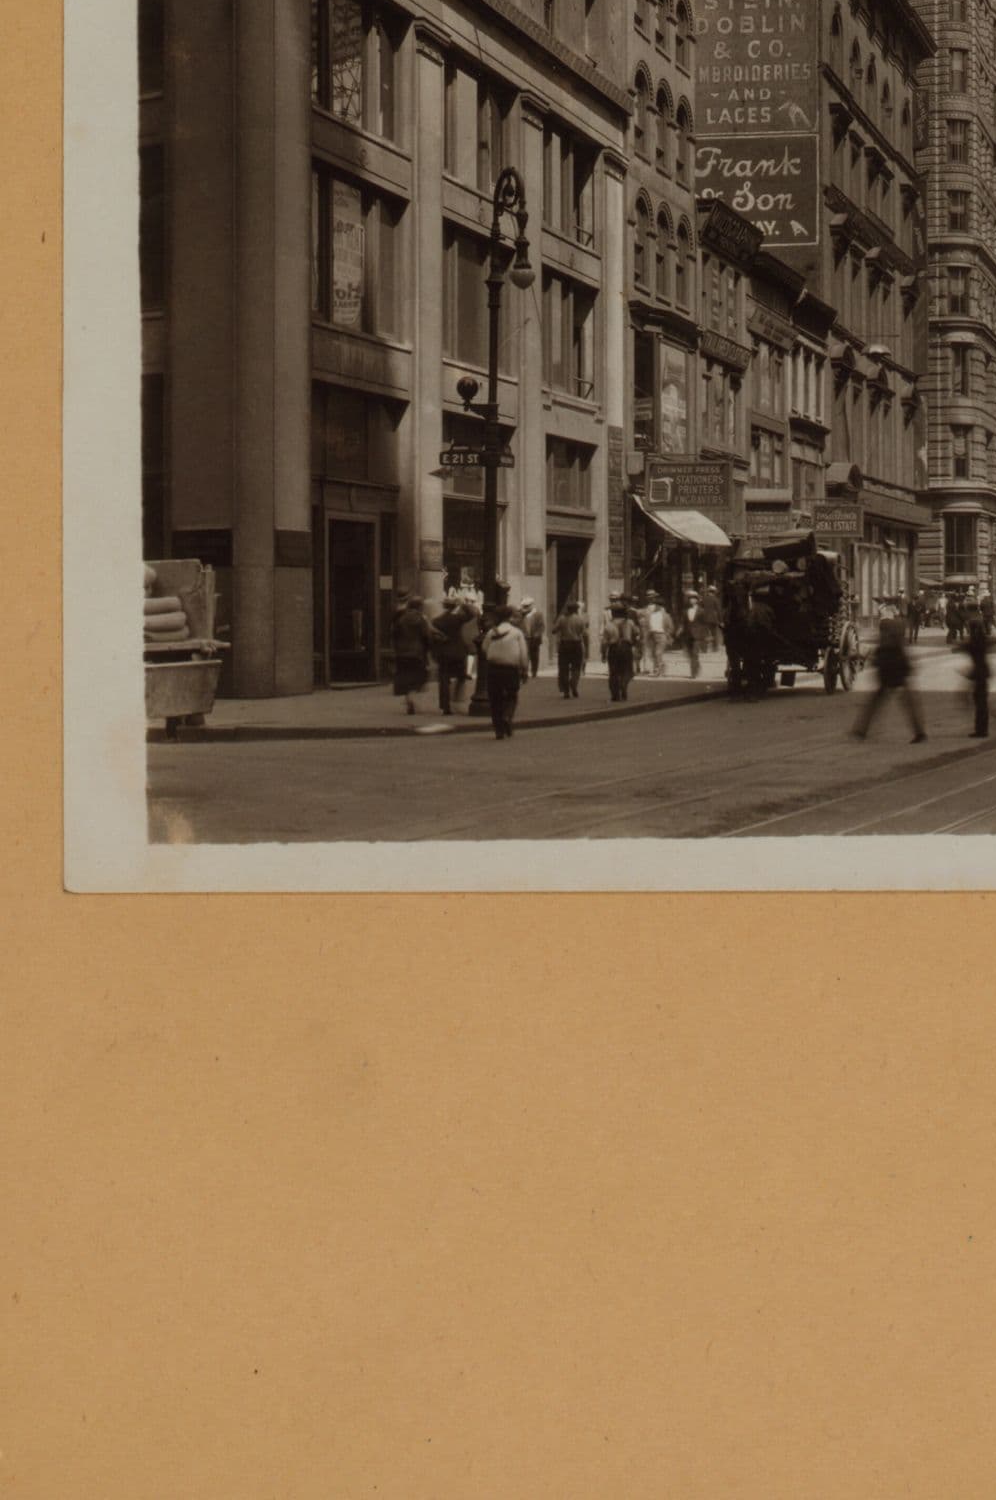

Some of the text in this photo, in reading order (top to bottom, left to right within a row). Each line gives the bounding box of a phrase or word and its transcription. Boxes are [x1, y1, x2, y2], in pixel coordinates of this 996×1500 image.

[694, 14, 806, 34] DOBLIN
[713, 39, 792, 59] & CO.
[696, 63, 812, 84] MBROIDERIES
[728, 88, 772, 102] AND
[706, 106, 772, 125] LACES
[694, 145, 801, 178] Frank
[731, 181, 796, 212] Son
[751, 220, 780, 237] AY.
[442, 454, 479, 463] E 21 ST
[675, 475, 724, 485] STATIONERS
[678, 485, 721, 495] PRINTERS
[815, 521, 857, 531] REAL ESTATE
